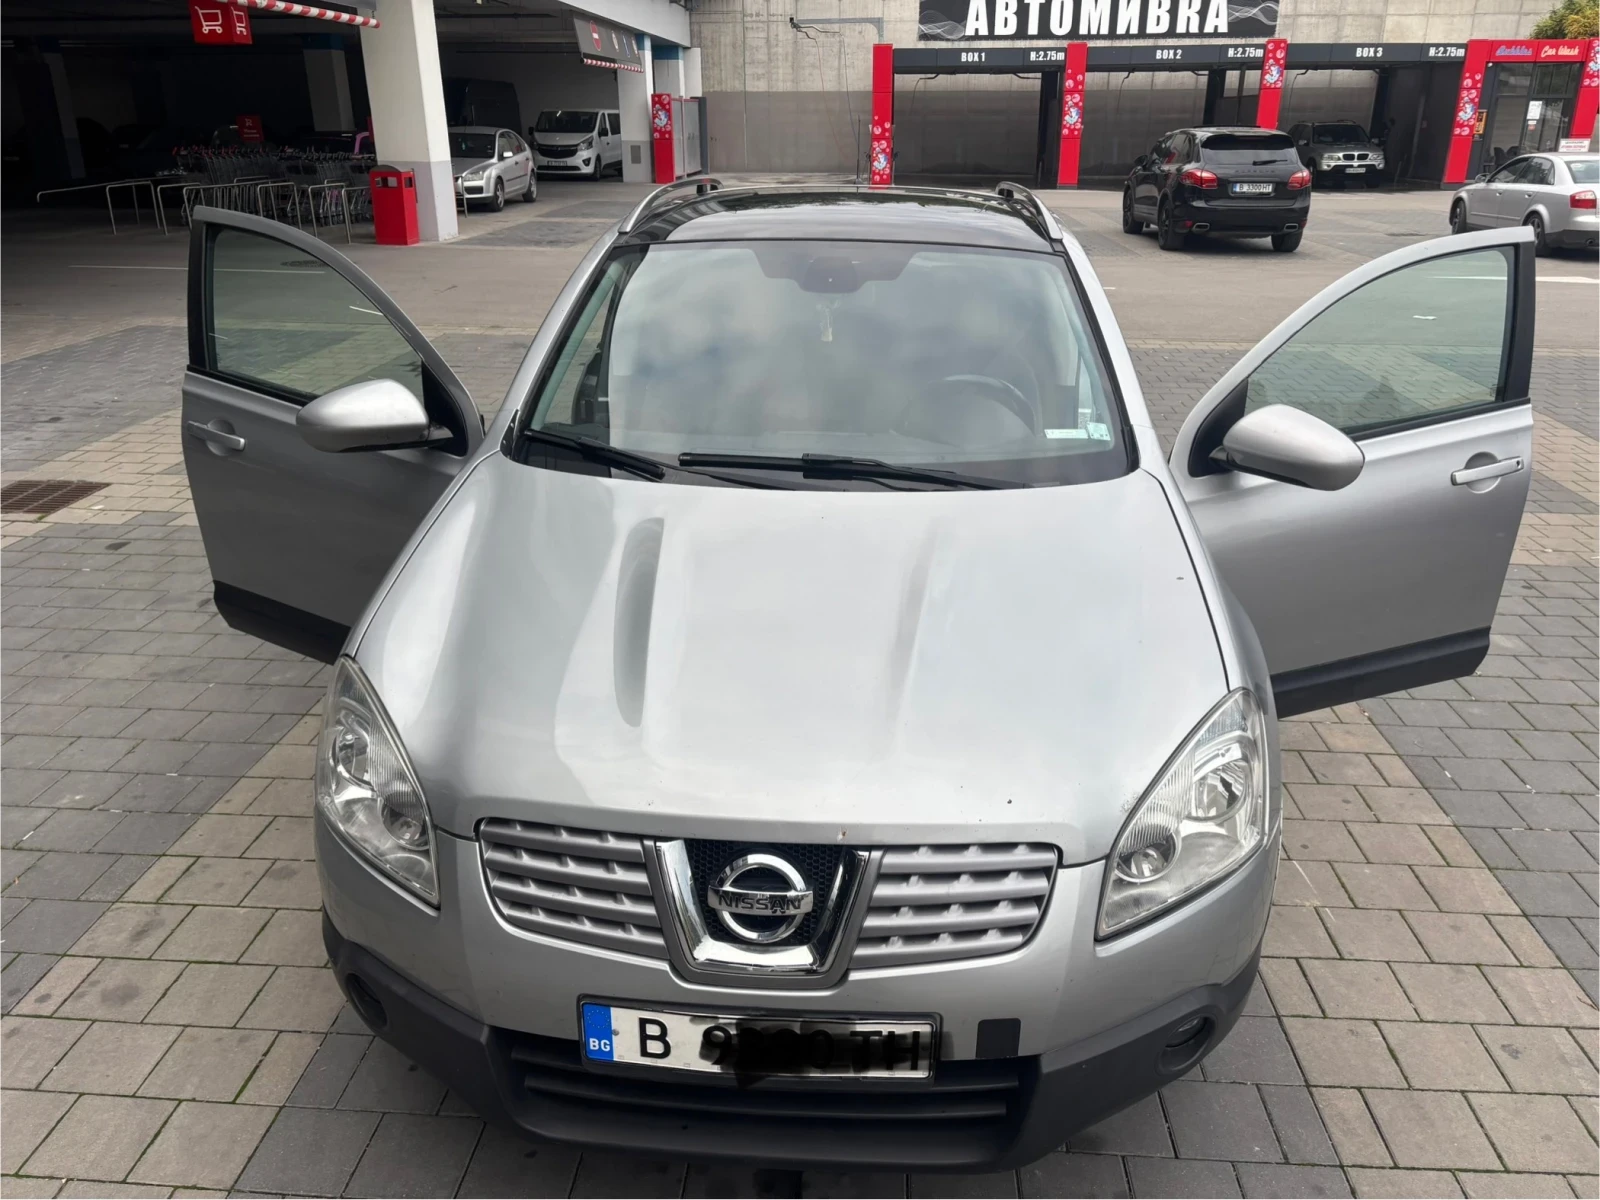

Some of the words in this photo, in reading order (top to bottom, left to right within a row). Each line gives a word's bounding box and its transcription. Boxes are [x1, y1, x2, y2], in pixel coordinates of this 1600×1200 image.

[965, 0, 1228, 36] АВТОМИВКА
[1029, 51, 1065, 61] H:2.75m
[1156, 49, 1174, 59] BOX
[1176, 49, 1182, 59] 2
[1228, 47, 1264, 58] H:2.75m
[1356, 47, 1375, 57] BOX
[1376, 47, 1383, 57] 3
[1428, 46, 1465, 57] H:2.75m
[1541, 45, 1556, 57] Car
[1558, 45, 1579, 56] Wash
[961, 52, 979, 62] BOX
[981, 52, 986, 61] 1
[718, 893, 801, 911] NISSAN
[639, 1017, 671, 1059] B
[589, 1038, 611, 1052] BG
